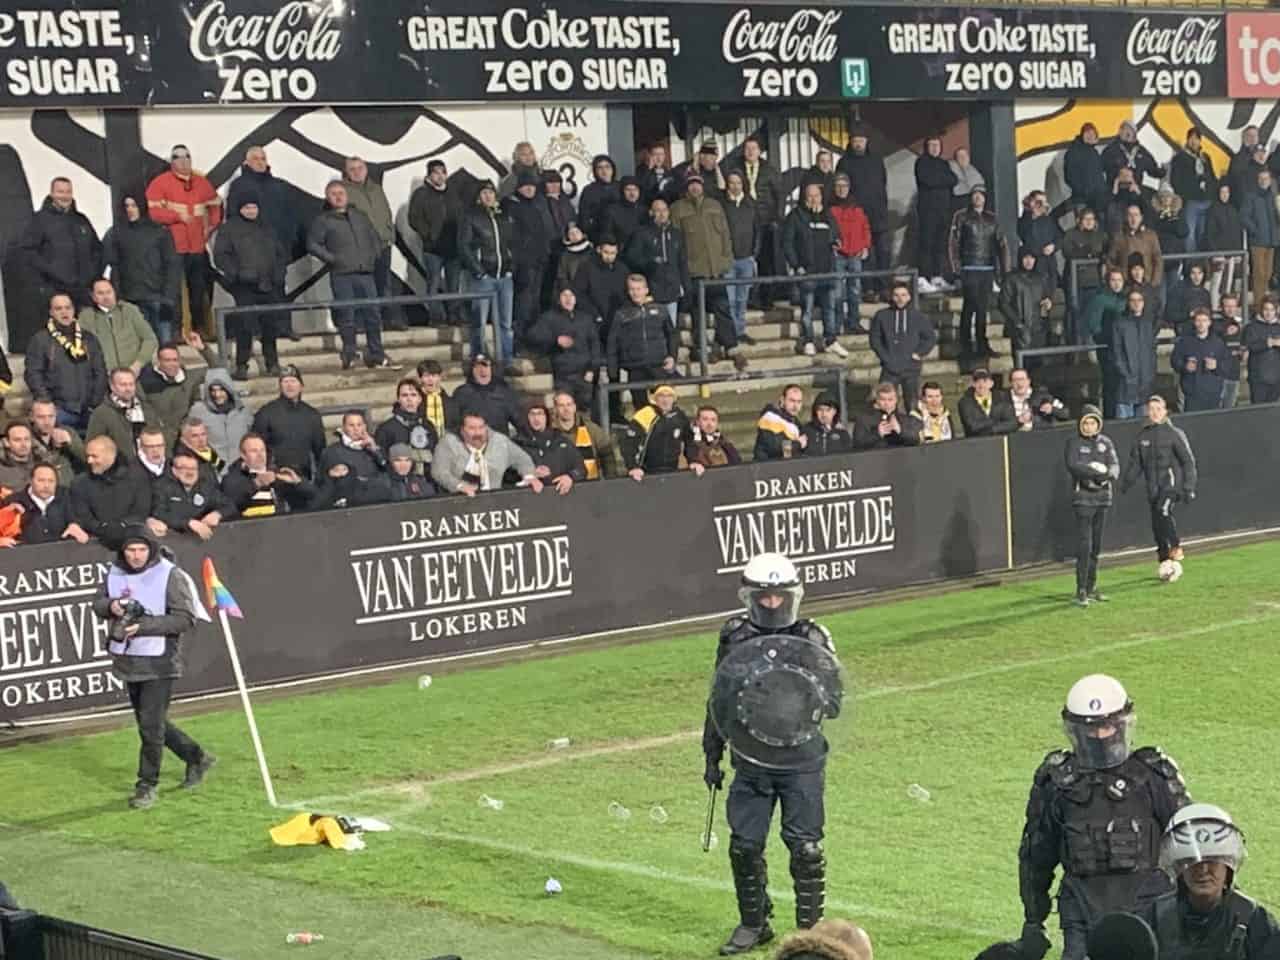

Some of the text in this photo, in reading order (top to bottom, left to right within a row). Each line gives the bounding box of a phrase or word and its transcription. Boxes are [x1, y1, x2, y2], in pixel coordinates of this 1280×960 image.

[17, 10, 135, 55] TASTE,
[190, 0, 342, 62] Coca-Cola
[407, 8, 681, 56] GREAT Coke TASTE,
[722, 8, 842, 64] Coca-Cola
[888, 17, 1097, 59] GREAT Coke TASTE,
[1126, 16, 1222, 66] Coca-Cola
[7, 58, 121, 96] SUGAR
[218, 68, 317, 101] zero
[484, 58, 668, 92] zero SUGAR
[743, 67, 818, 97] zero
[945, 59, 1087, 91] zero SUGAR
[1142, 67, 1200, 95] zero
[541, 106, 588, 128] VAK
[559, 162, 577, 199] 3
[755, 470, 854, 499] DRANKEN
[401, 508, 521, 541] DRANKEN
[714, 496, 896, 566] VAN EETVELDE
[0, 562, 113, 597] RANKEN
[352, 536, 573, 614] VAN EETVELDE
[0, 601, 110, 671] EETVE
[409, 606, 527, 641] LOKEREN
[2, 672, 124, 707] OKEREN
